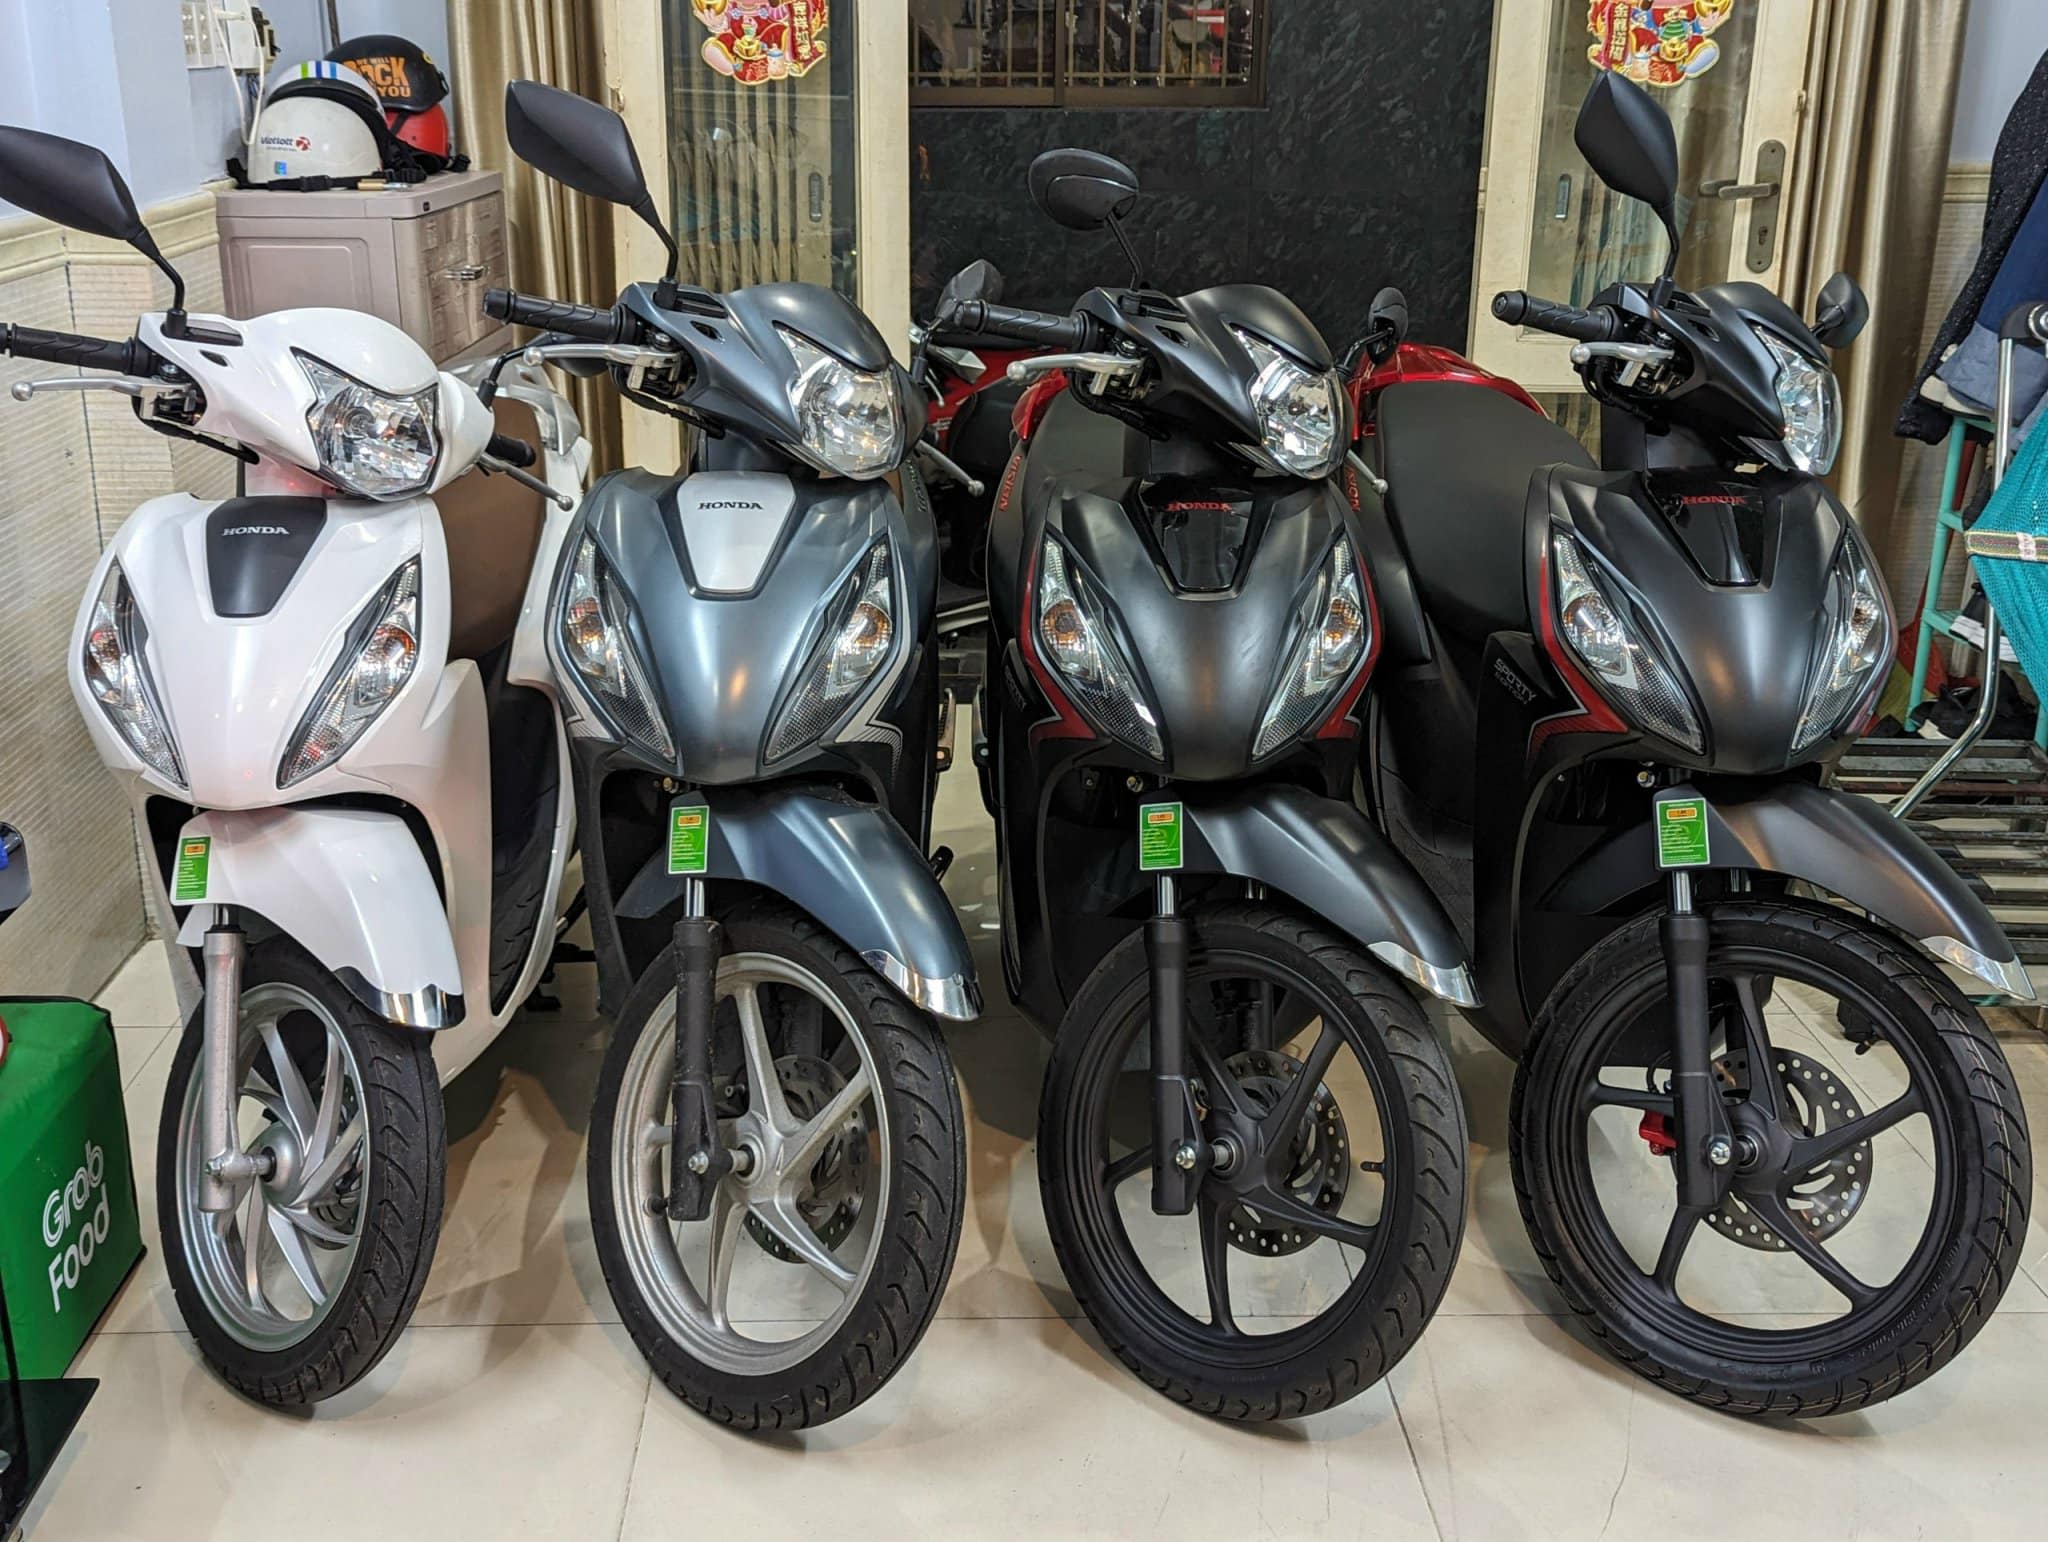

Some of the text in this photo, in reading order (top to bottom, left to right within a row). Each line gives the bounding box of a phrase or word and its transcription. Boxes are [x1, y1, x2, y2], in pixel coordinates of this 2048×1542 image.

[377, 86, 411, 98] YOU
[697, 501, 764, 511] HONDA
[1166, 500, 1234, 512] HONDA
[1682, 495, 1746, 505] HONDA
[221, 526, 290, 536] HONDA
[1494, 658, 1537, 702] SPORTY
[42, 1139, 105, 1248] Grab
[48, 1182, 110, 1314] Food
